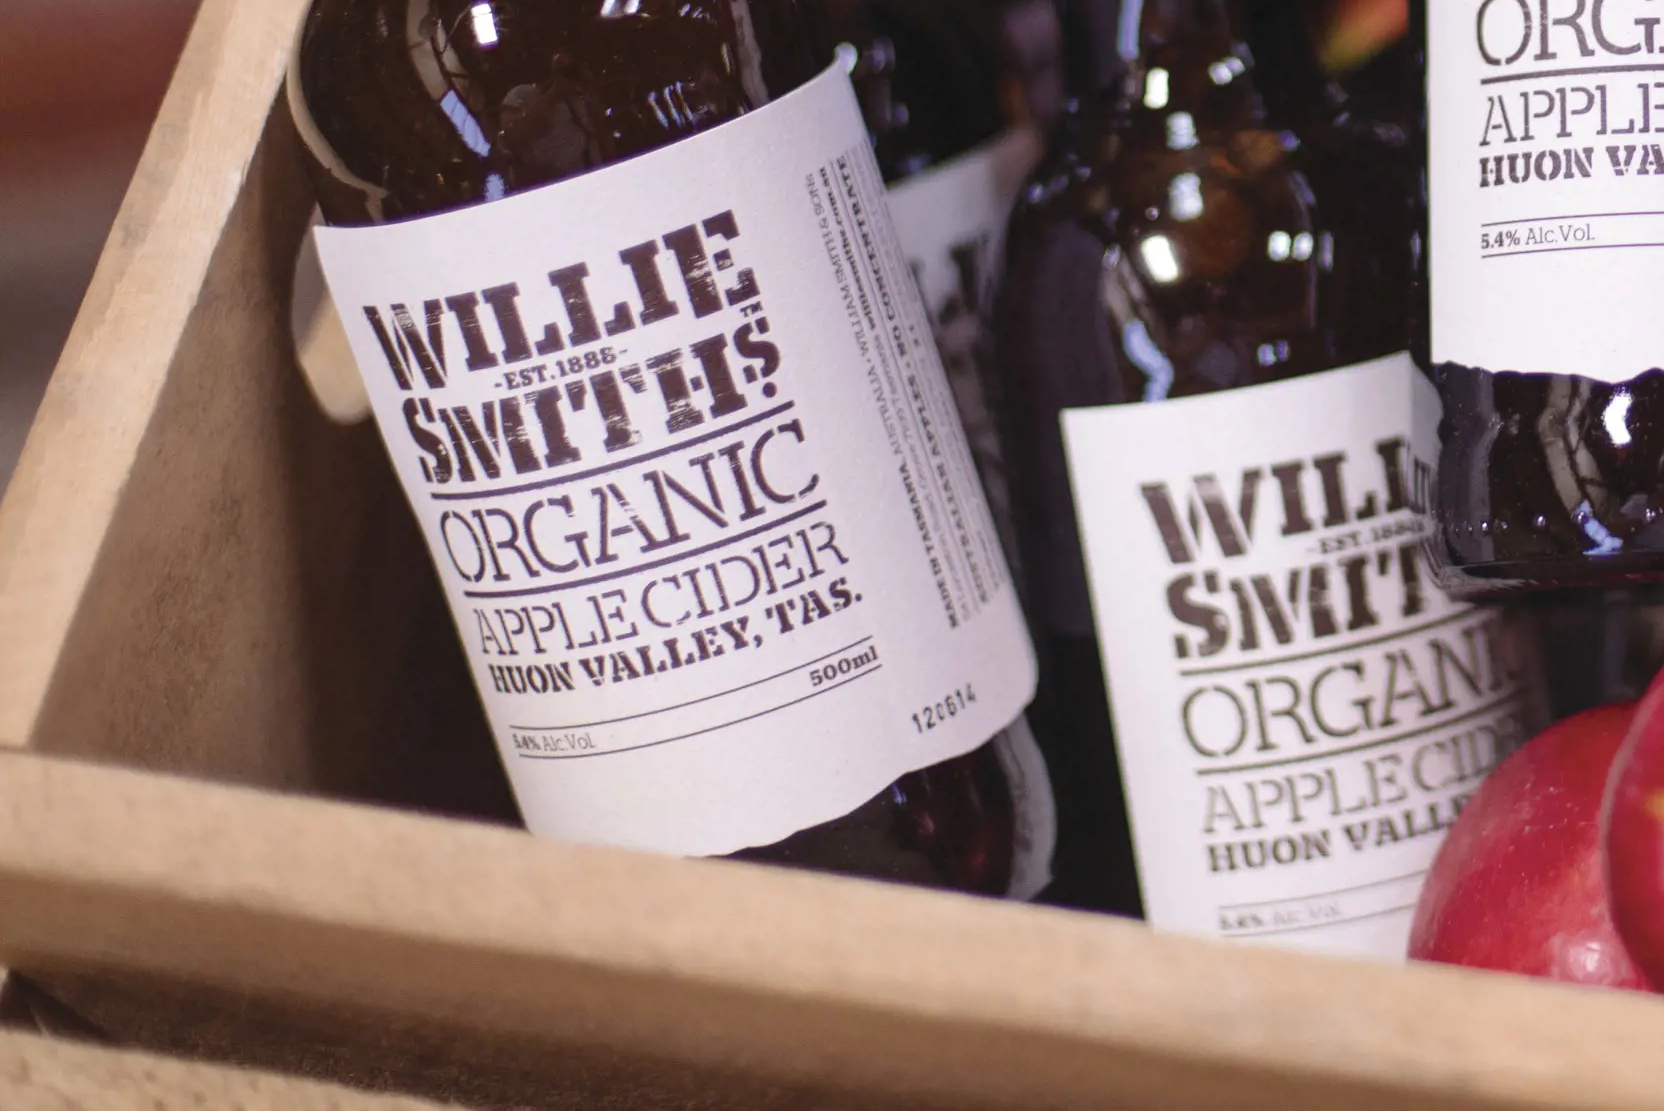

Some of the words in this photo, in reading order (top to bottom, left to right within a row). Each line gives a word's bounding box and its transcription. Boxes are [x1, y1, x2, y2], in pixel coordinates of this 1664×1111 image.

[1479, 146, 1594, 188] HUON
[1481, 229, 1521, 250] 5.4%
[363, 209, 762, 391] WILLIE
[440, 418, 819, 583] ORGANIC
[473, 589, 638, 655] APPLE
[641, 520, 850, 629] CIDER
[487, 662, 575, 694] HUON
[579, 616, 764, 687] VALLEY,
[765, 576, 864, 635] TAS.
[1166, 542, 1425, 660] SMIT
[809, 644, 879, 687] 500ml
[1203, 755, 1408, 833] APPLE
[1207, 830, 1331, 873] HUON
